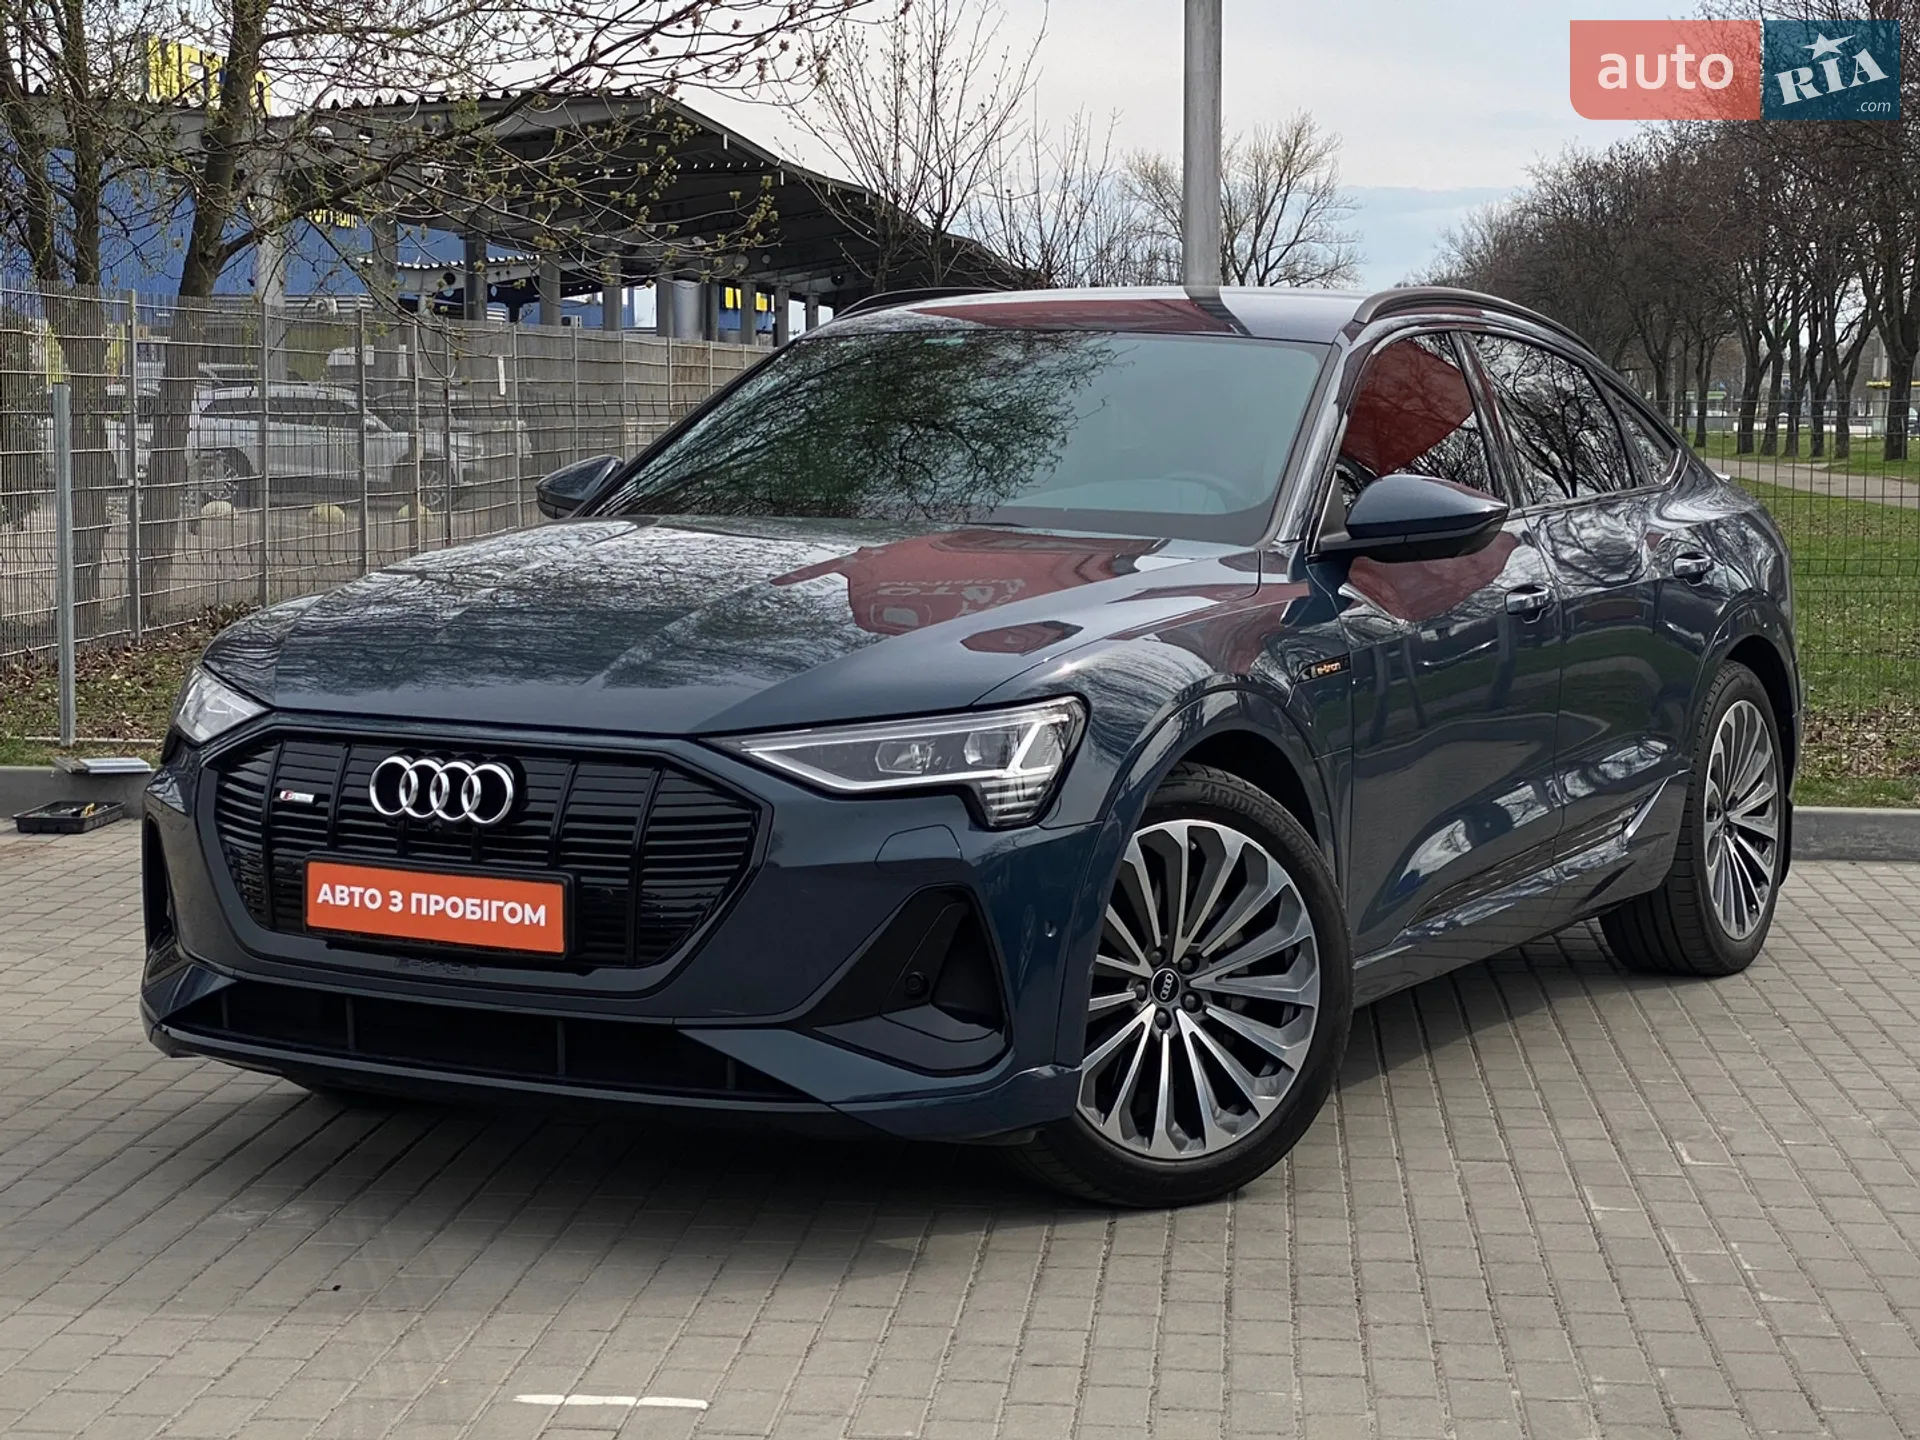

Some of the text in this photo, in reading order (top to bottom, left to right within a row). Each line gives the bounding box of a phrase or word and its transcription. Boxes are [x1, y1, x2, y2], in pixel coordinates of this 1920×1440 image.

[316, 883, 546, 927] АВТО З ПРОБІГОМ
